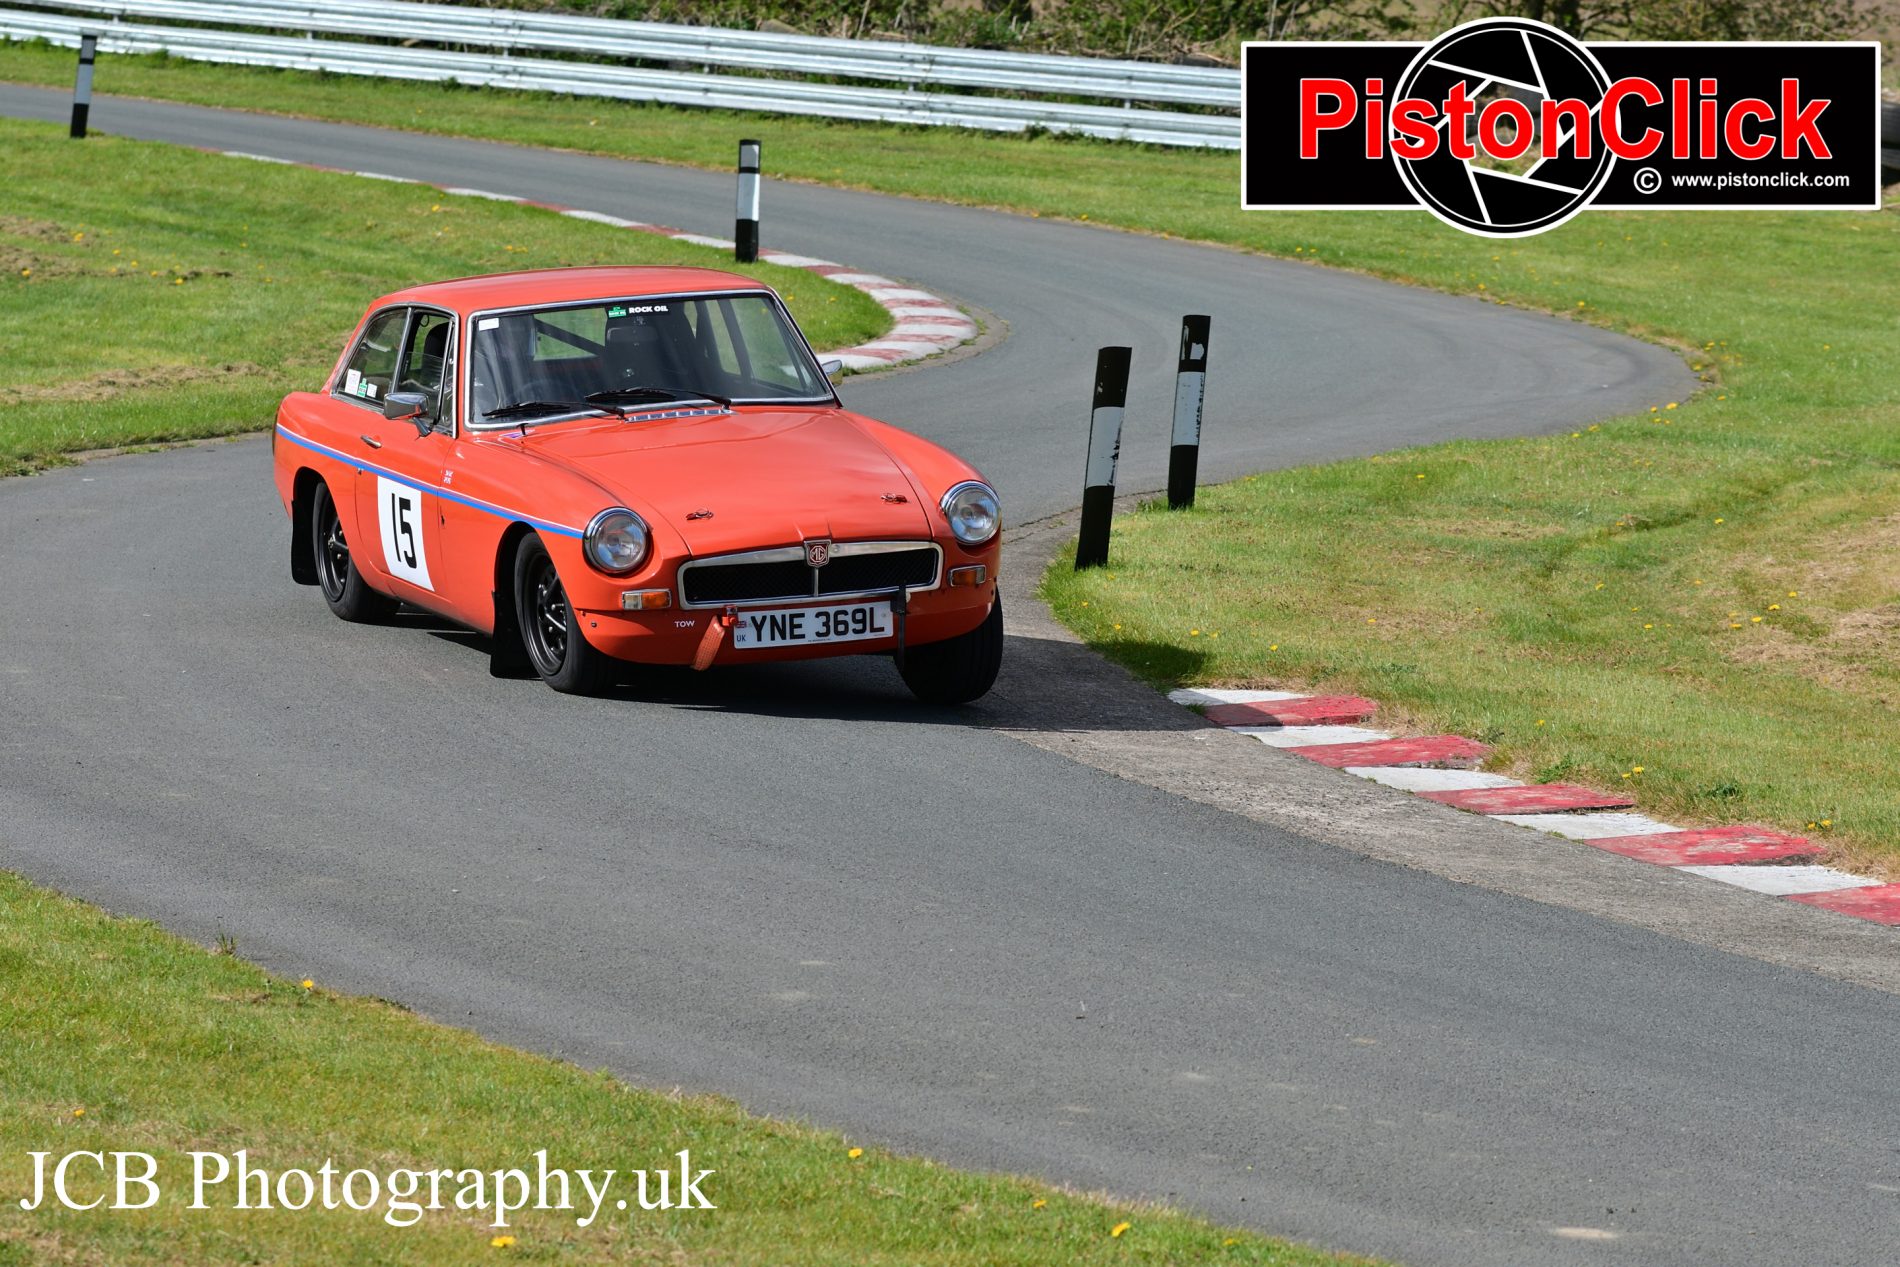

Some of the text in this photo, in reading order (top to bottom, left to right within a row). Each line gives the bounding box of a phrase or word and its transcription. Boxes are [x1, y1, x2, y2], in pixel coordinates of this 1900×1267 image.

[628, 306, 653, 314] ROCK
[391, 493, 417, 569] 15
[810, 546, 826, 561] MG
[674, 620, 695, 628] TOW
[751, 607, 885, 642] YNE 369L
